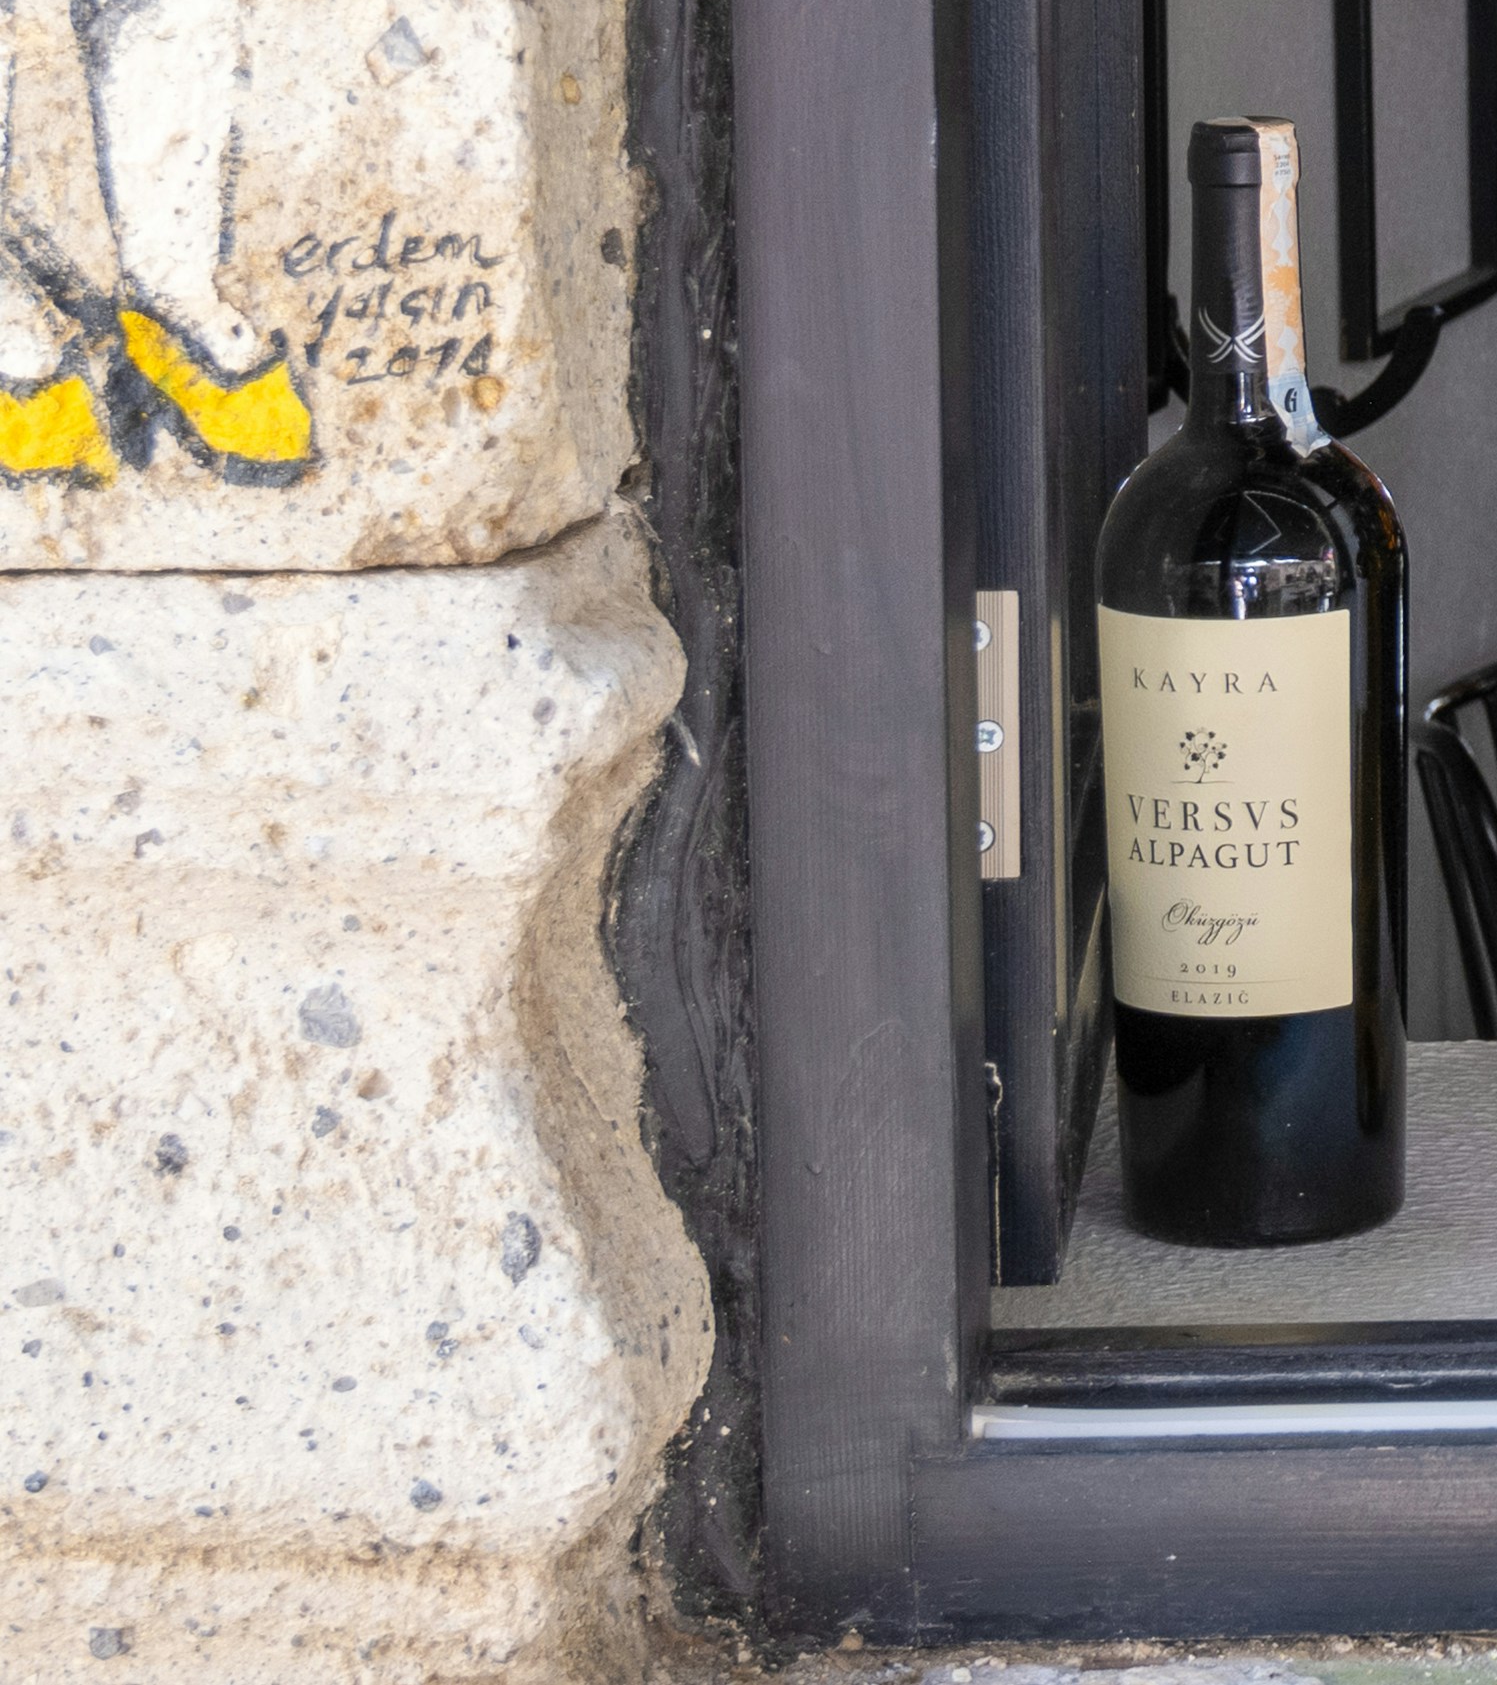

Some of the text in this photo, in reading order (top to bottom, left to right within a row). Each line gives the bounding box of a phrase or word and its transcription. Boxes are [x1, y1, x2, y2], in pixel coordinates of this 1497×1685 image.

[282, 207, 513, 278] erdem
[1132, 666, 1279, 695] KAYRA
[1127, 793, 1300, 832] VERSVS
[1128, 836, 1301, 870] ALPAGUT
[1180, 962, 1237, 978] 2019
